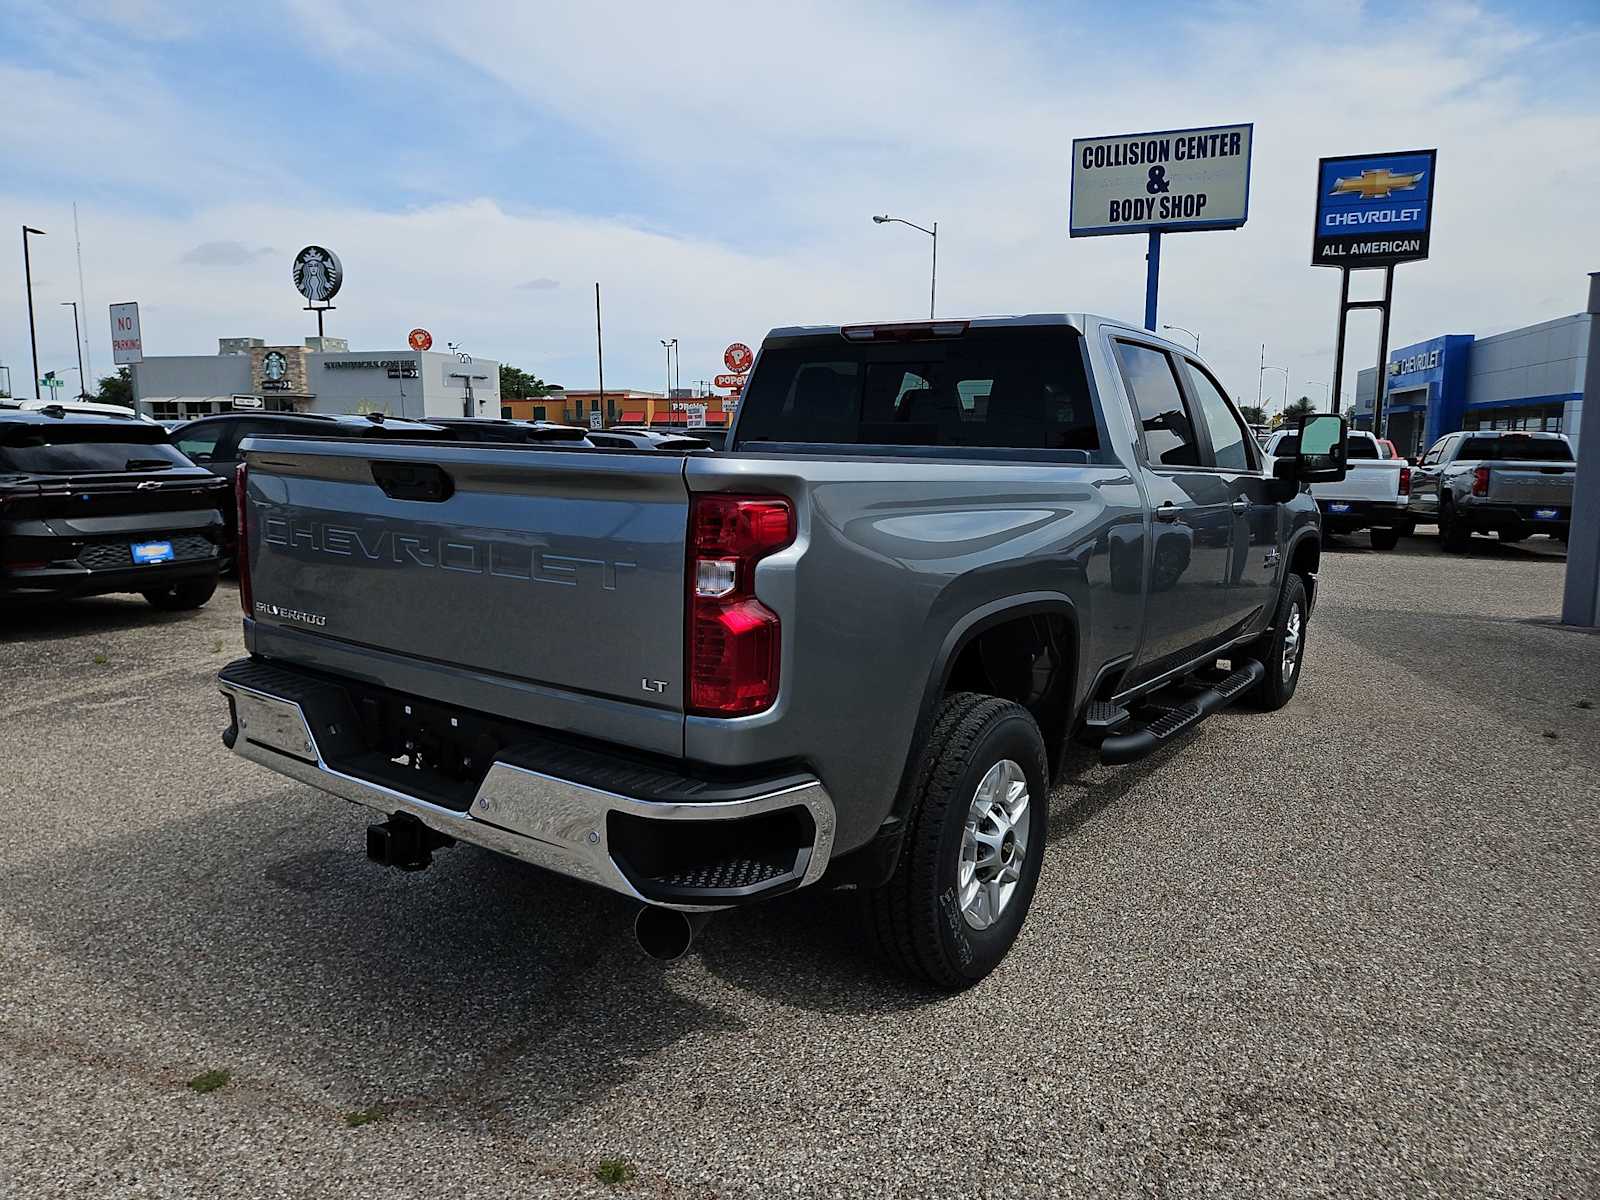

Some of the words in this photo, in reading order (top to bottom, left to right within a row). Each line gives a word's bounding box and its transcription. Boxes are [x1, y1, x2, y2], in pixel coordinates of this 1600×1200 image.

[1082, 139, 1170, 170] COLLISION
[1174, 132, 1241, 161] CENTER
[1146, 165, 1170, 195] &
[1109, 198, 1156, 223] BODY
[1159, 193, 1207, 220] SHOP
[1325, 208, 1421, 226] CHEVROLET
[1322, 244, 1346, 256] ALL
[1350, 240, 1420, 255] AMERICAN
[118, 316, 131, 330] NO
[113, 340, 141, 351] PARKING
[1401, 349, 1440, 375] CHEVROLET
[260, 516, 637, 591] CHEVROLET
[255, 601, 326, 626] SILVERADO
[641, 678, 667, 693] LT
